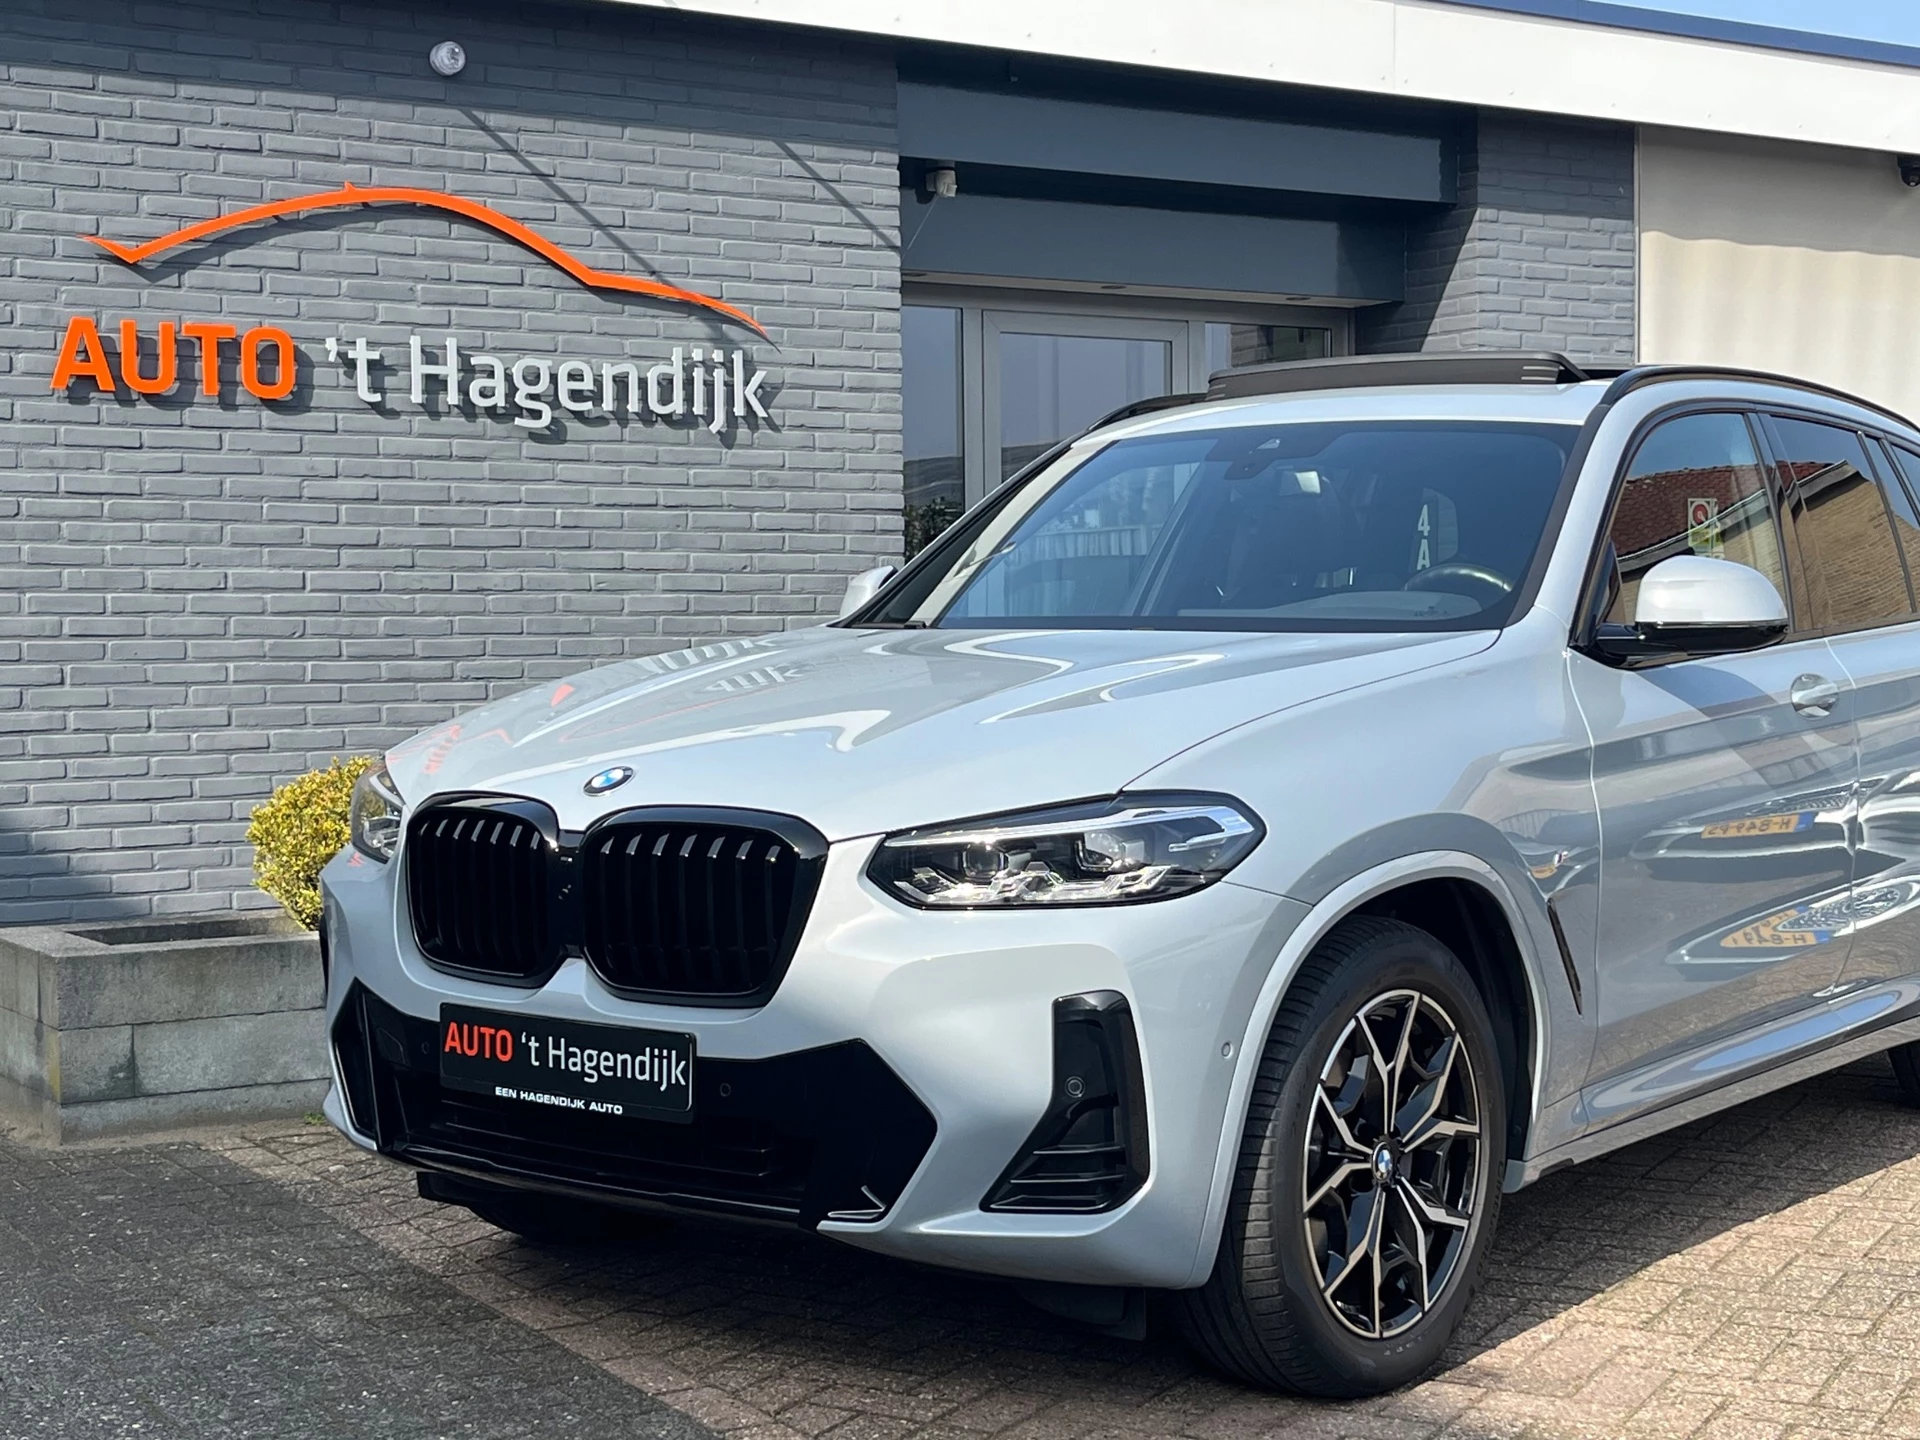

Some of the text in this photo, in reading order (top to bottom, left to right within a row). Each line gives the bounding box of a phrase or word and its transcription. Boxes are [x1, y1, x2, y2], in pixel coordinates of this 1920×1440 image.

[50, 315, 297, 399] AUTO
[409, 335, 769, 434] Hagendijk
[444, 1021, 514, 1063] AUTO
[548, 1035, 687, 1092] Hagendijk
[495, 1086, 623, 1115] EEN HAGENDIJK AUTO
